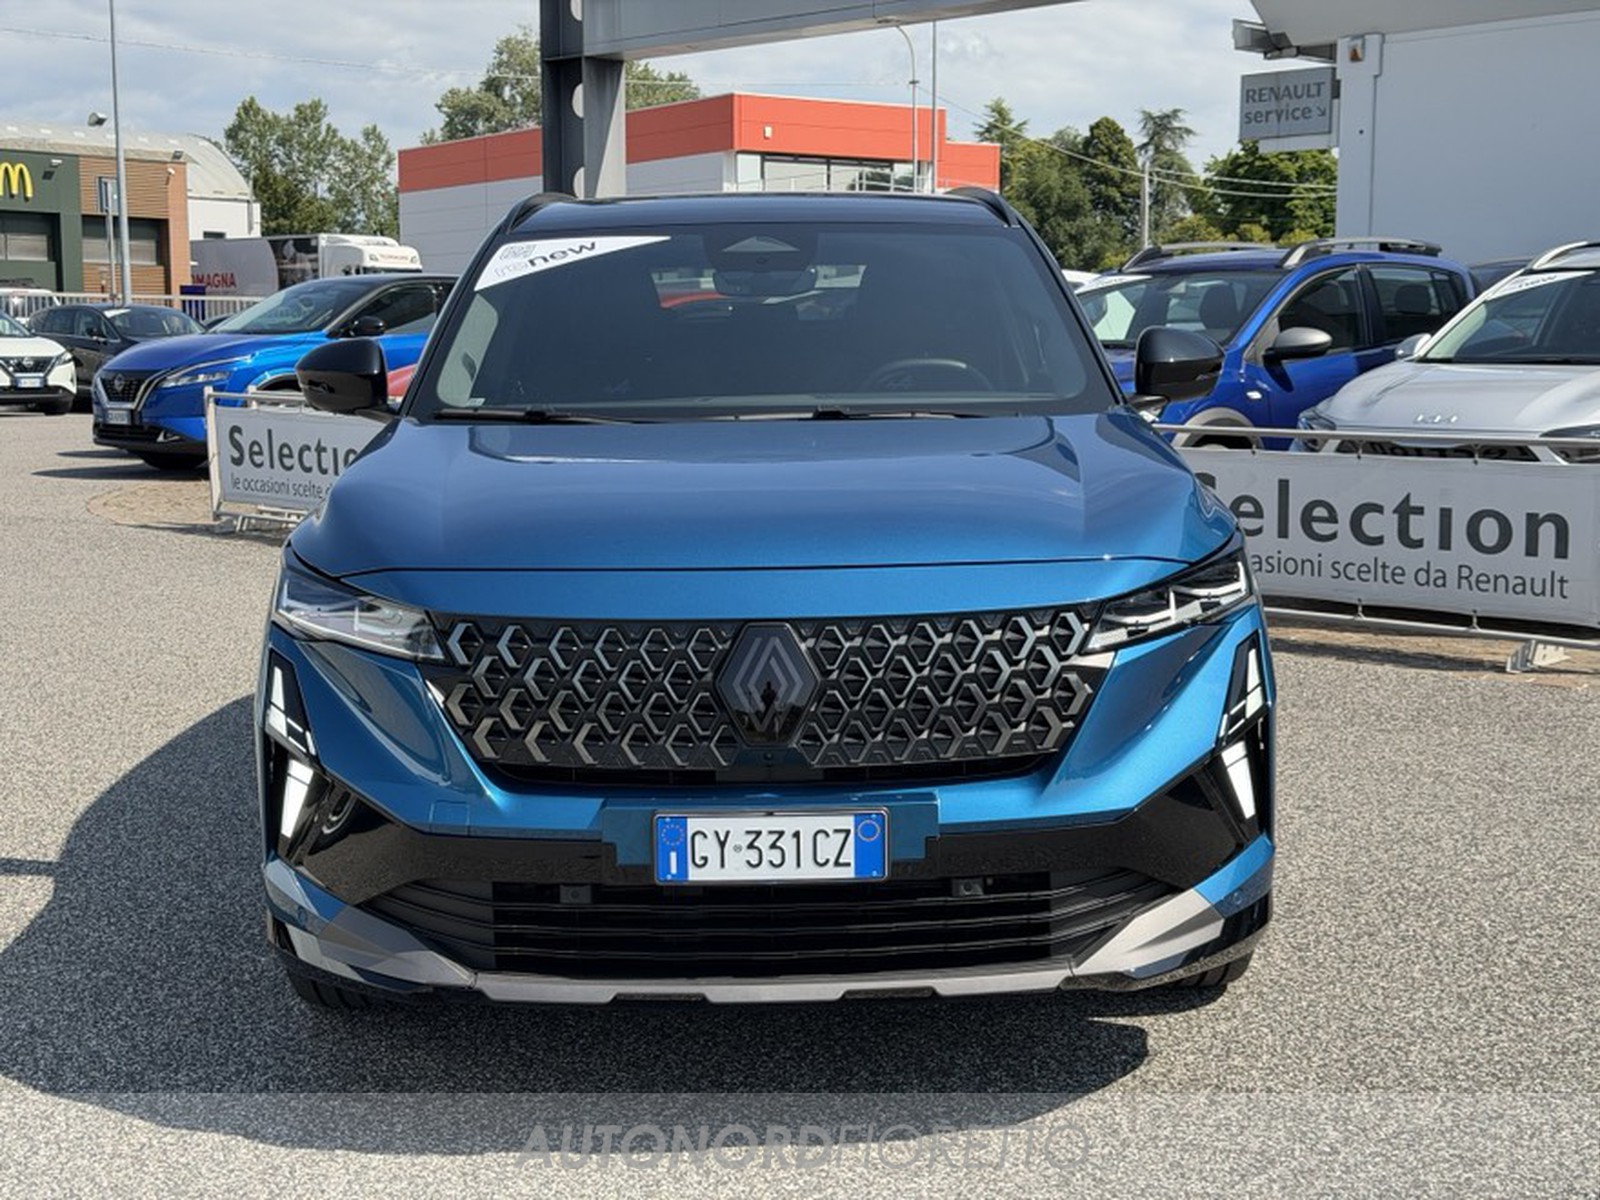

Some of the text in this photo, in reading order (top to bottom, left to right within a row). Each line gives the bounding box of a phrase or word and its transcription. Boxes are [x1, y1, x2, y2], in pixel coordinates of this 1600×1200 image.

[1245, 82, 1326, 104] RENAULT
[1244, 104, 1312, 124] service
[243, 477, 290, 495] occasioni
[292, 480, 323, 499] scelte
[1195, 472, 1569, 560] election
[1331, 556, 1406, 585] scelte
[1414, 560, 1447, 589] da
[1457, 565, 1569, 600] Renault
